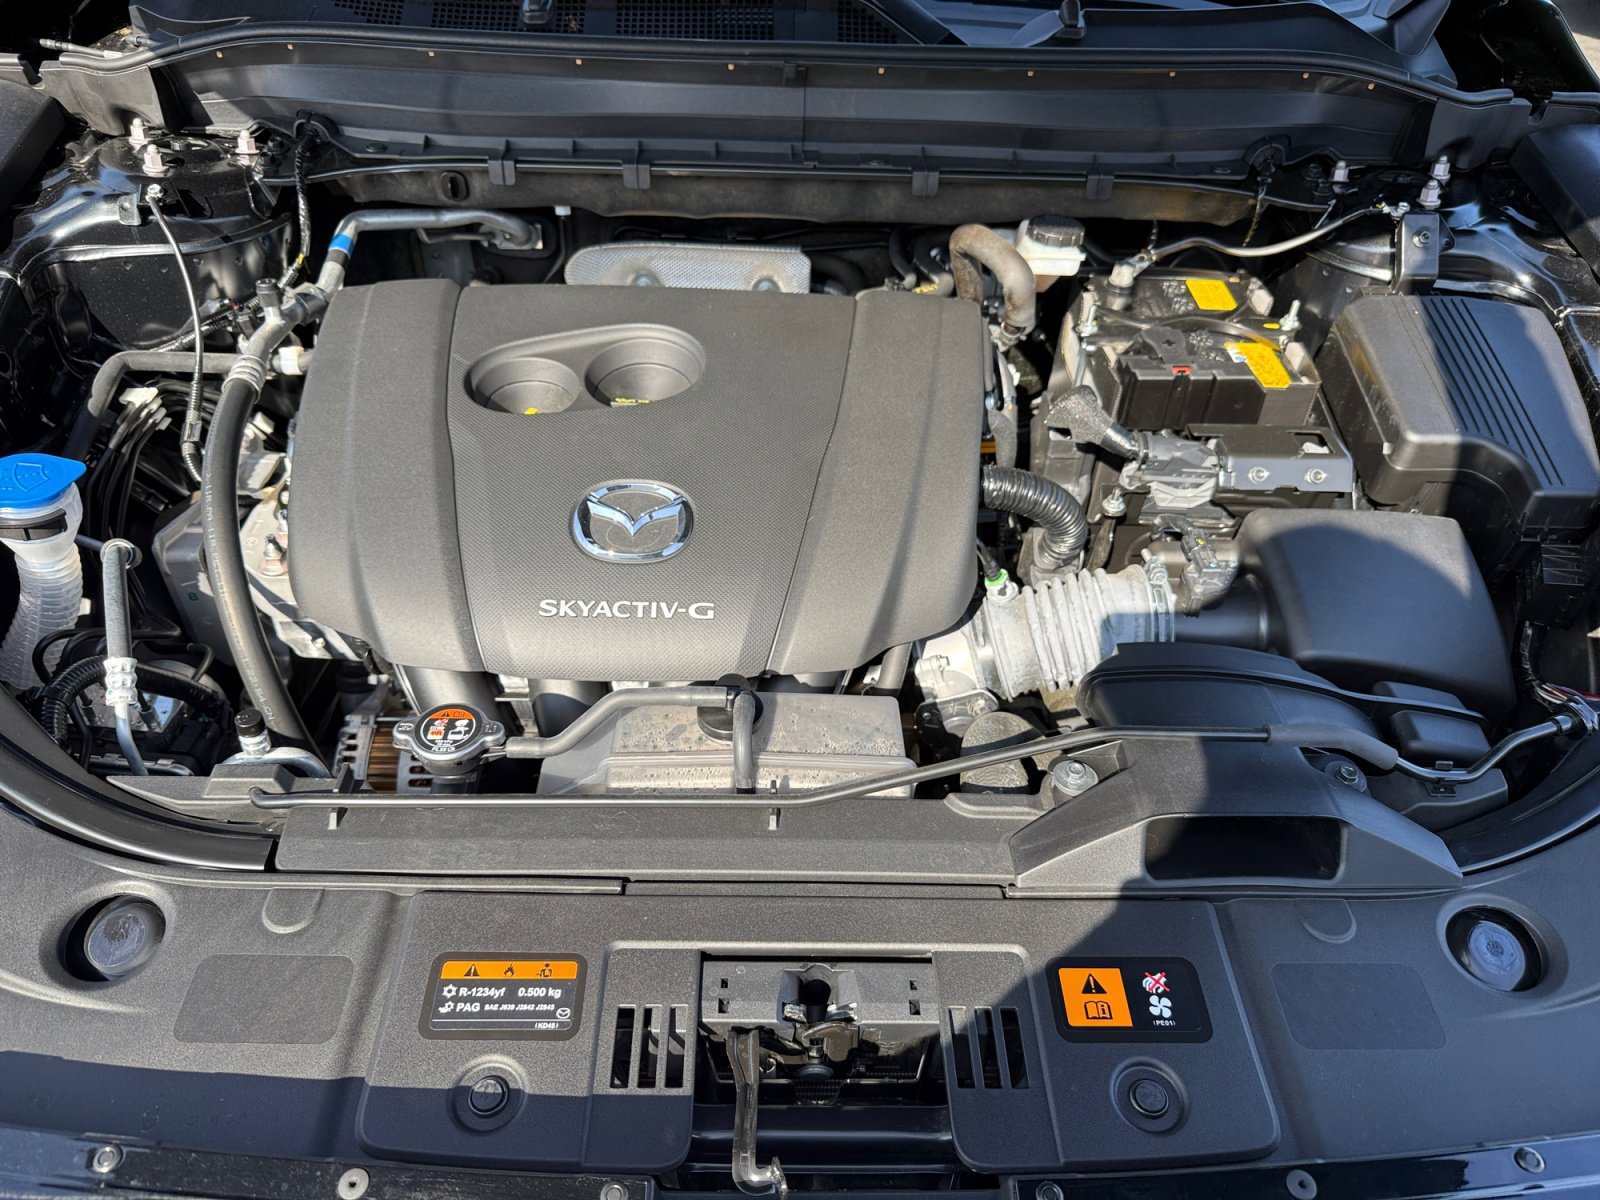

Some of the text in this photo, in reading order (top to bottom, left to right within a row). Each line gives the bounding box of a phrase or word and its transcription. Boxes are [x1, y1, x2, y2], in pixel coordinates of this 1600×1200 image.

[538, 599, 715, 620] SKYACTIV-G
[458, 987, 562, 998] R-1234yf 0.500 kg
[456, 1002, 481, 1012] PAG
[484, 1003, 499, 1011] SAE
